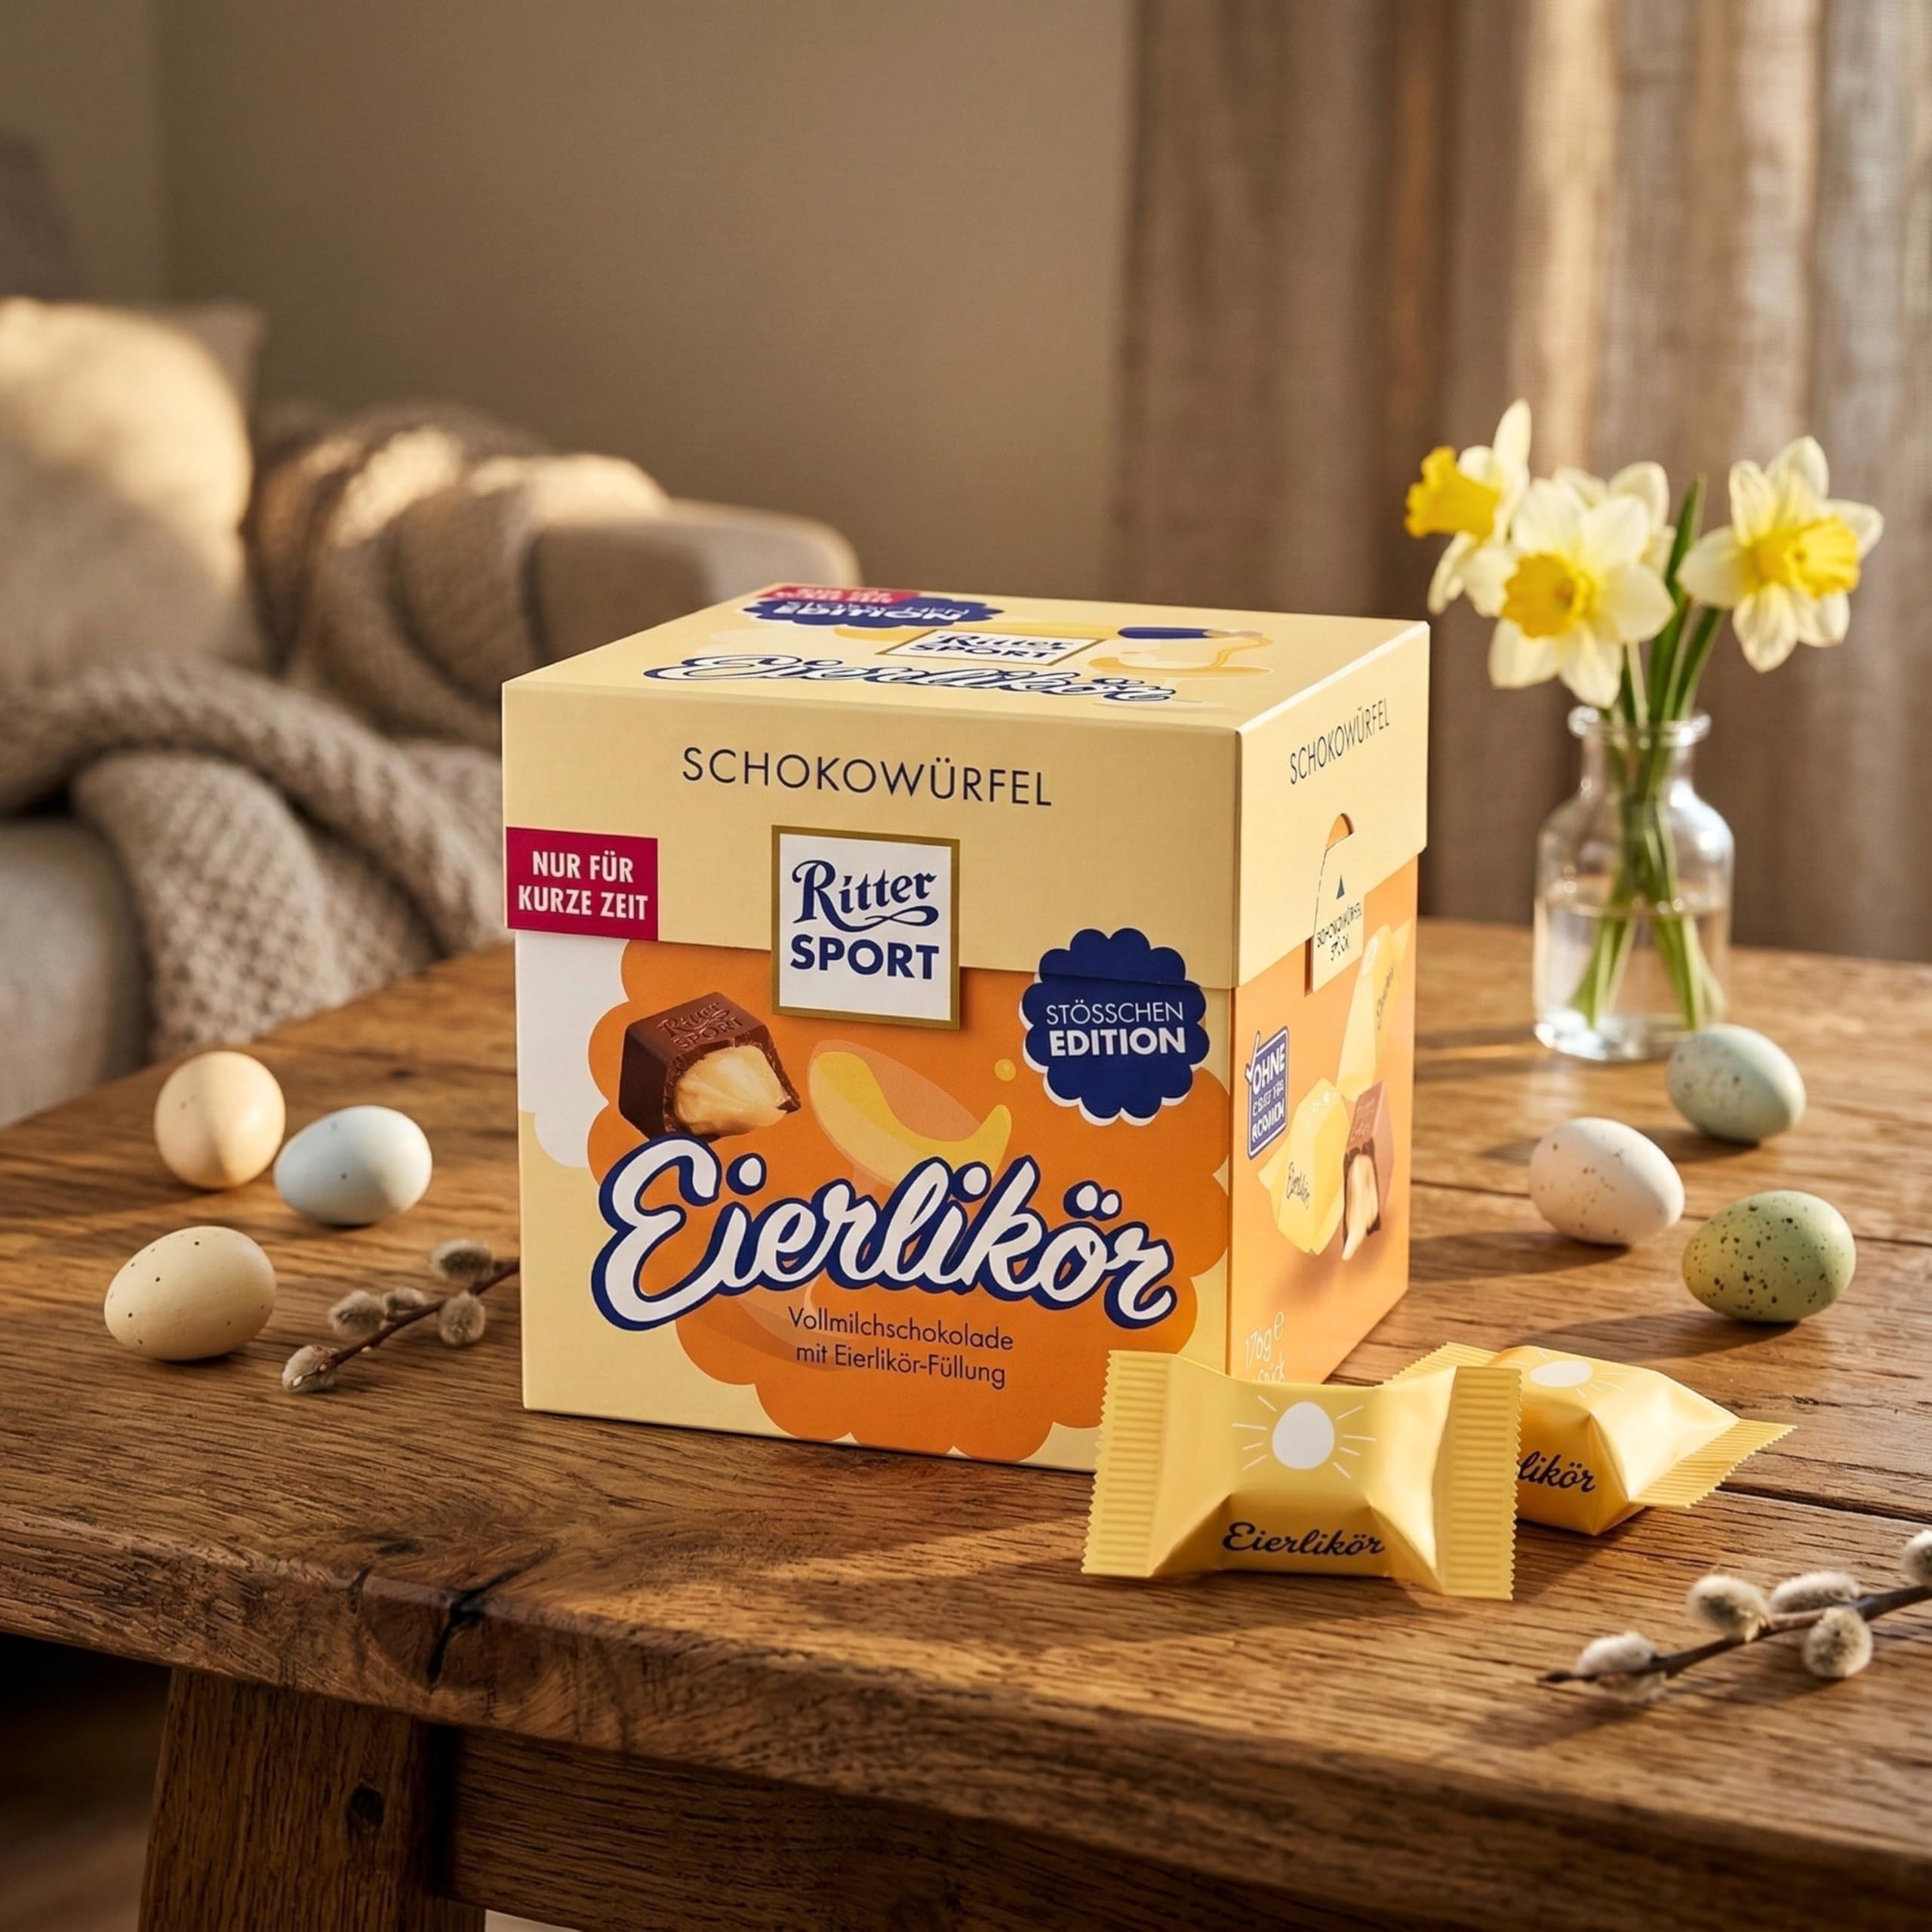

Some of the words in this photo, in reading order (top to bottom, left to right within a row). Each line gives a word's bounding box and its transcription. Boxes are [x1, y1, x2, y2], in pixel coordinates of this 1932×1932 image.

[1290, 698, 1389, 785] SCHOKOWÜRFEL
[681, 746, 1052, 807] SCHOKOWÜRFEL
[532, 851, 581, 879] NUR
[589, 850, 634, 884] FÜR
[518, 885, 592, 915] KURZE
[600, 891, 649, 921] ZEIT
[791, 859, 940, 934] Ritter
[790, 934, 940, 980] SPORT
[672, 1016, 743, 1049] SPORT
[1046, 998, 1184, 1025] STÖSSCHEN
[1049, 1026, 1186, 1057] EDITION
[1252, 1042, 1285, 1095] OHNE
[591, 1134, 1178, 1332] Eierlikör
[788, 1306, 1014, 1351] Vollmilchschokolade
[796, 1343, 828, 1364] mit
[835, 1343, 1006, 1390] Eierlikör-Füllung
[1517, 1450, 1597, 1493] likör
[1222, 1521, 1386, 1556] Eierlikör
